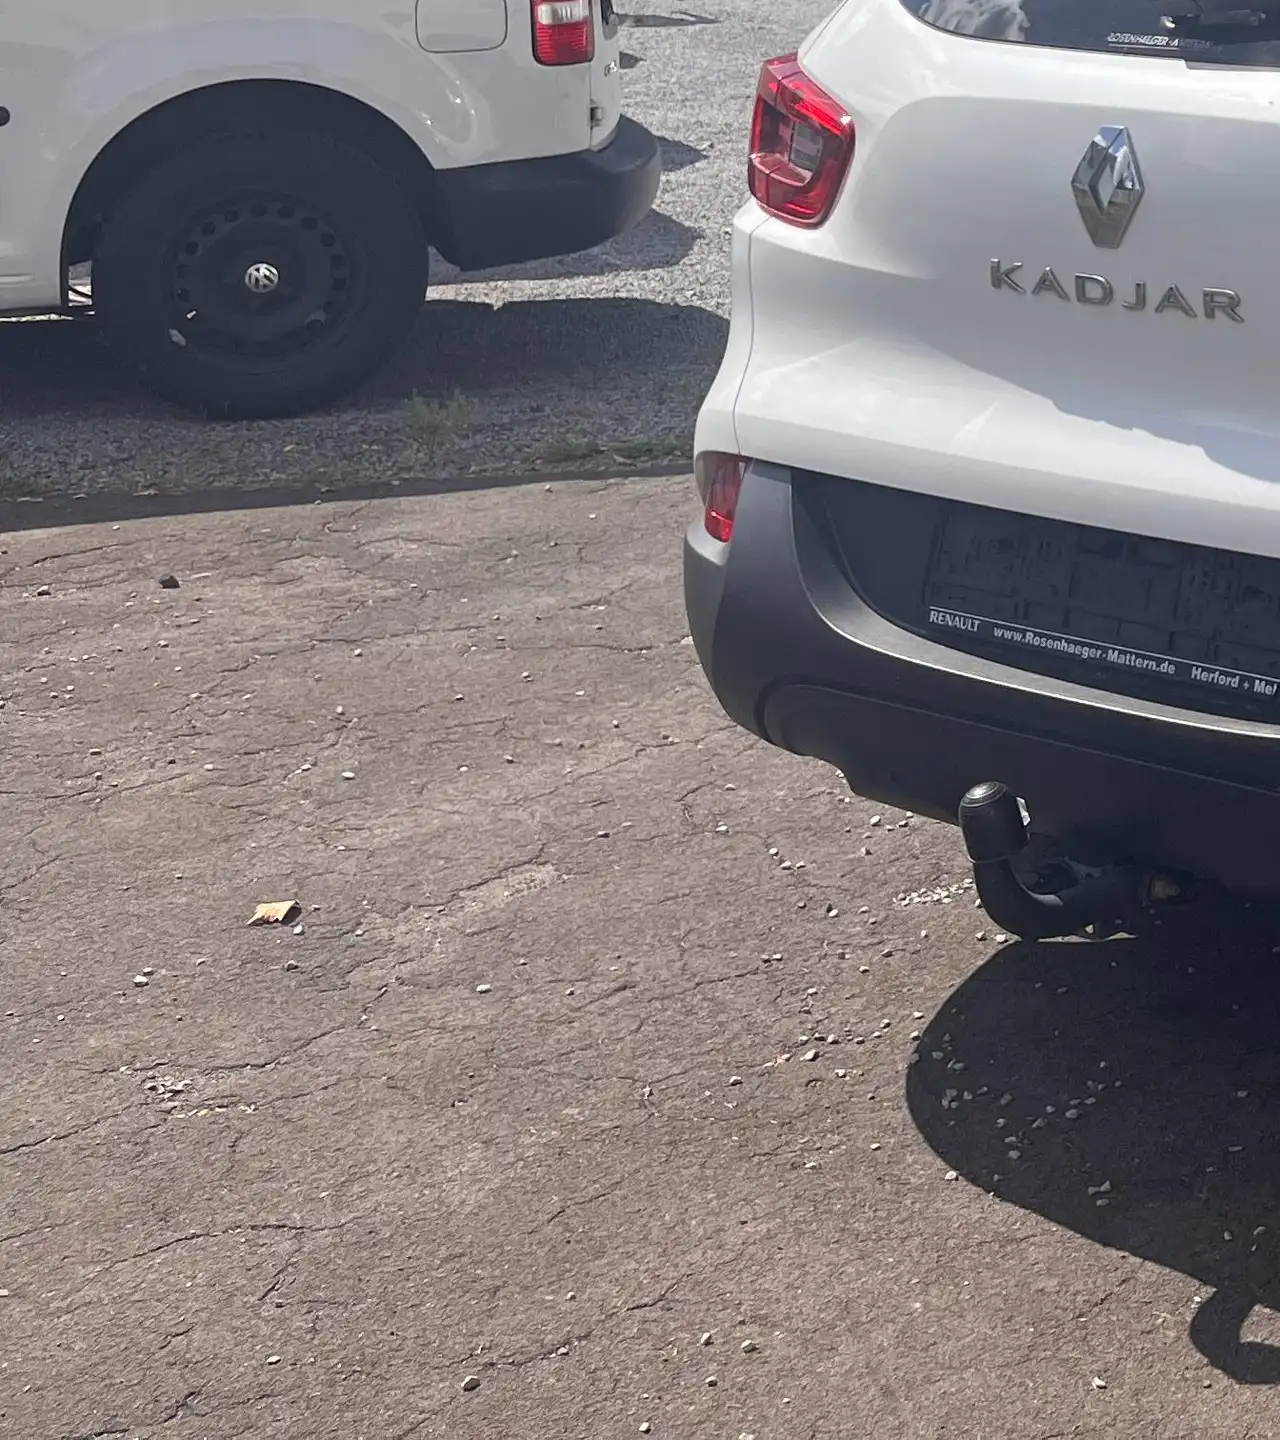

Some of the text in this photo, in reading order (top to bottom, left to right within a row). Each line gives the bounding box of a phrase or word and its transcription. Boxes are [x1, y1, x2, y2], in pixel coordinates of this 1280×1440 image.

[990, 257, 1245, 323] KADJAR
[929, 610, 981, 632] RENAULT
[993, 626, 1177, 675] www.Rosenhaeger-Mattern.de
[1191, 666, 1239, 688] Herford
